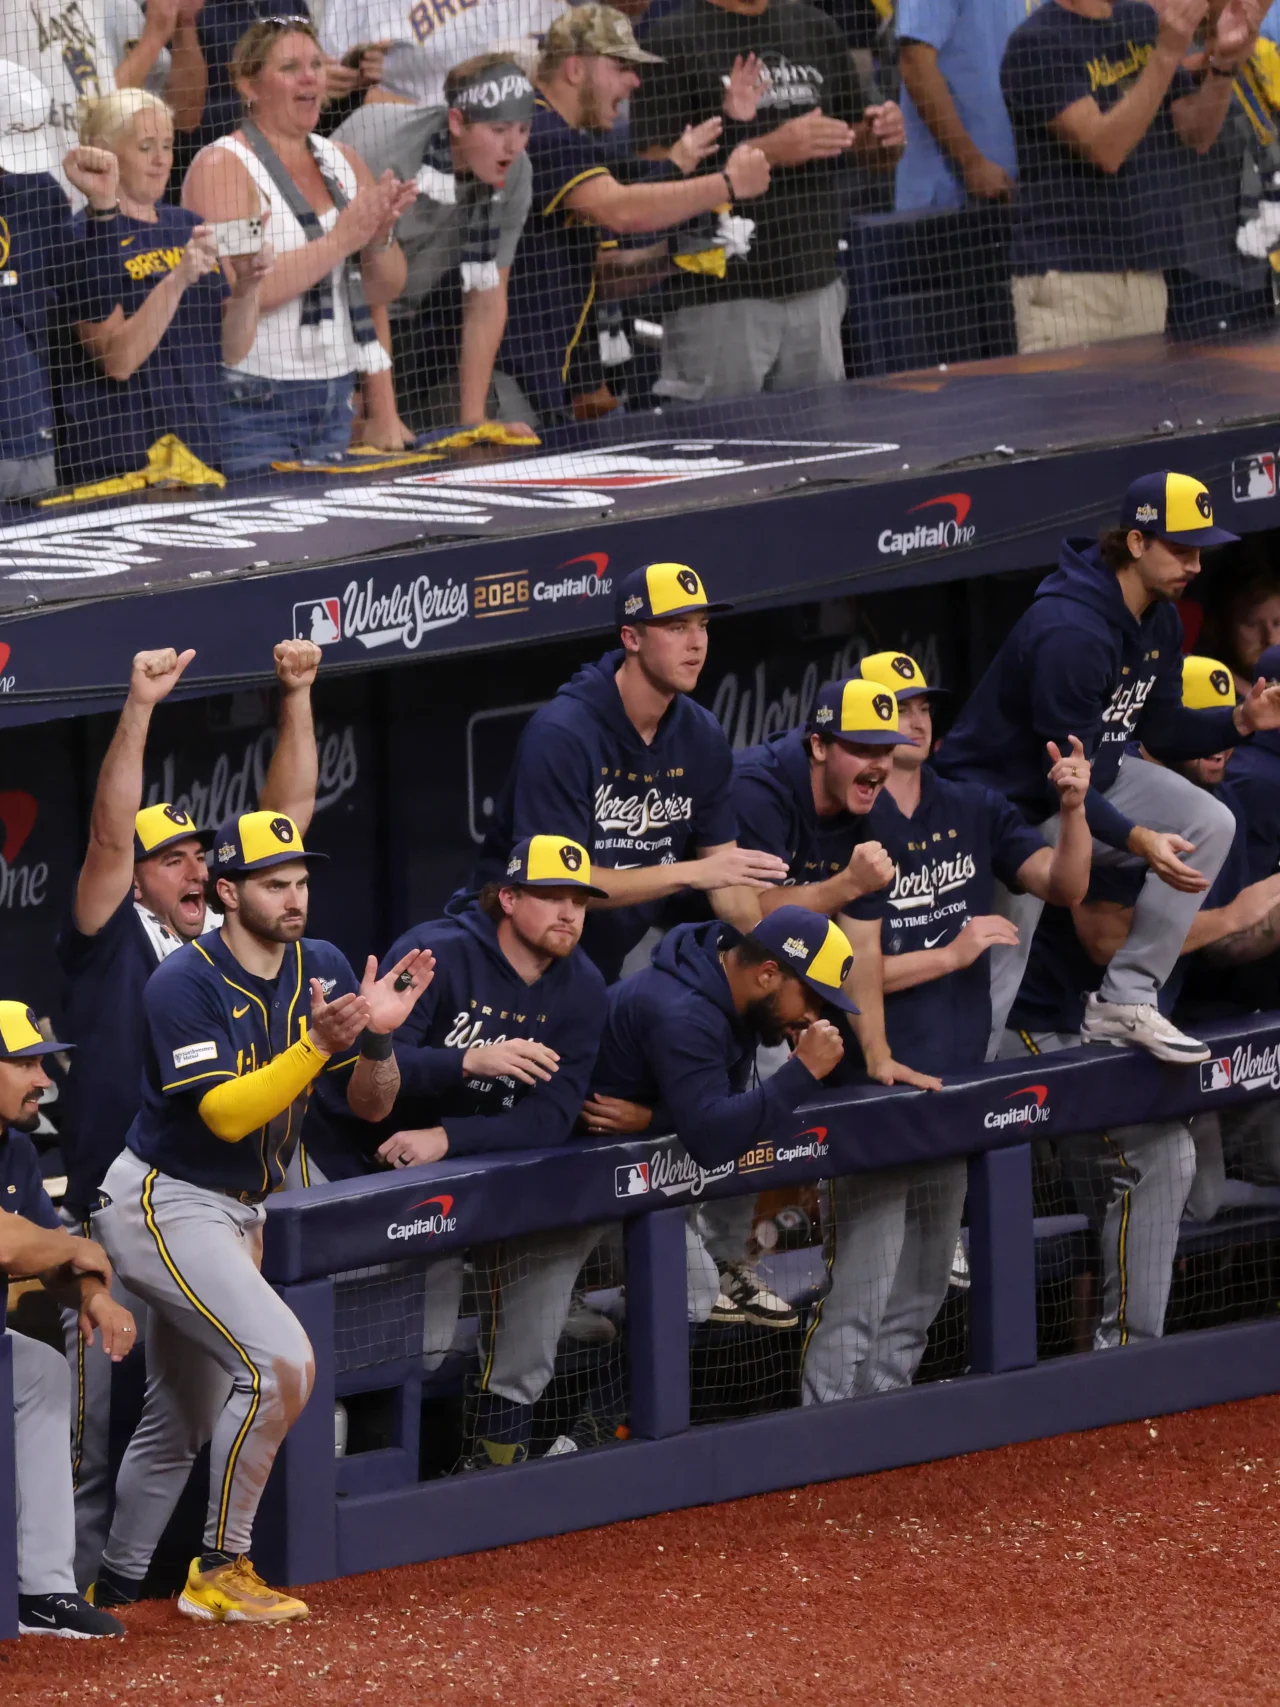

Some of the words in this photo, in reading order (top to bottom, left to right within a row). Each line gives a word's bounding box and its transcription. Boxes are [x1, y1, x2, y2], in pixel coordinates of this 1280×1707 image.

[474, 580, 530, 609] 2026
[613, 838, 634, 850] LIKE
[890, 917, 903, 929] NO
[903, 914, 929, 928] TIME
[738, 1147, 774, 1168] 2026
